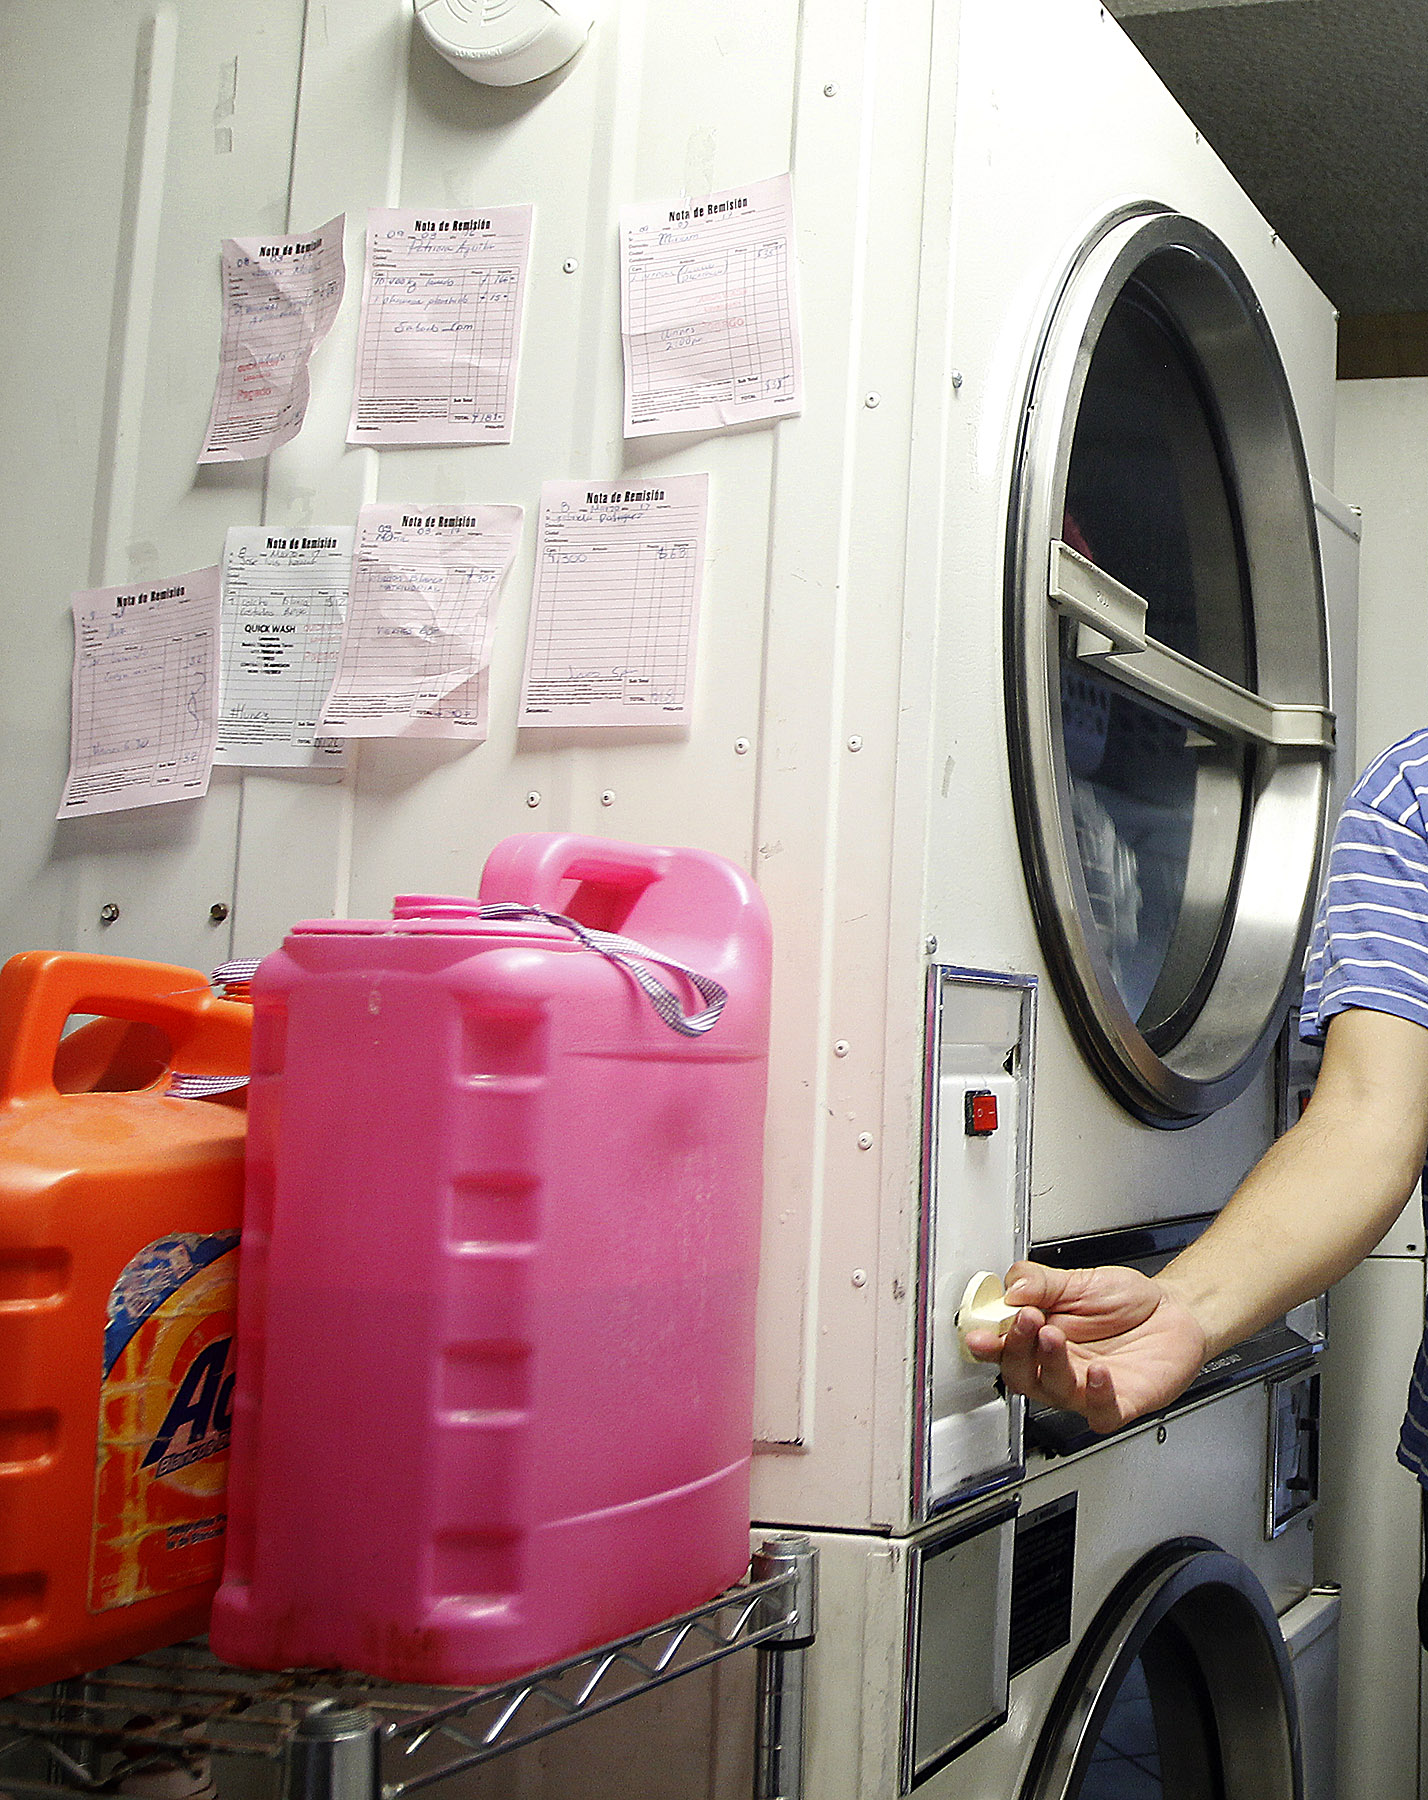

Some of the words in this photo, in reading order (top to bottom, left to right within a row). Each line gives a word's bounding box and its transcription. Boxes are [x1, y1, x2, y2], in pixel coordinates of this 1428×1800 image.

[668, 211, 691, 222] Nota
[693, 207, 705, 218] de
[707, 197, 748, 215] Remisión
[414, 220, 436, 231] Nota
[438, 220, 450, 231] de
[452, 219, 491, 231] Remisión
[586, 492, 608, 504] Nota
[610, 491, 621, 503] de
[624, 490, 665, 503] Remisión
[401, 515, 422, 527] Nota
[424, 516, 436, 528] de
[438, 516, 477, 528] Remisión
[266, 537, 287, 550] Nota
[289, 537, 300, 550] de
[301, 537, 337, 549] Remisión
[116, 596, 136, 608] Nota
[138, 593, 148, 605] de
[244, 624, 271, 633] QUICK
[272, 625, 296, 633] WASH
